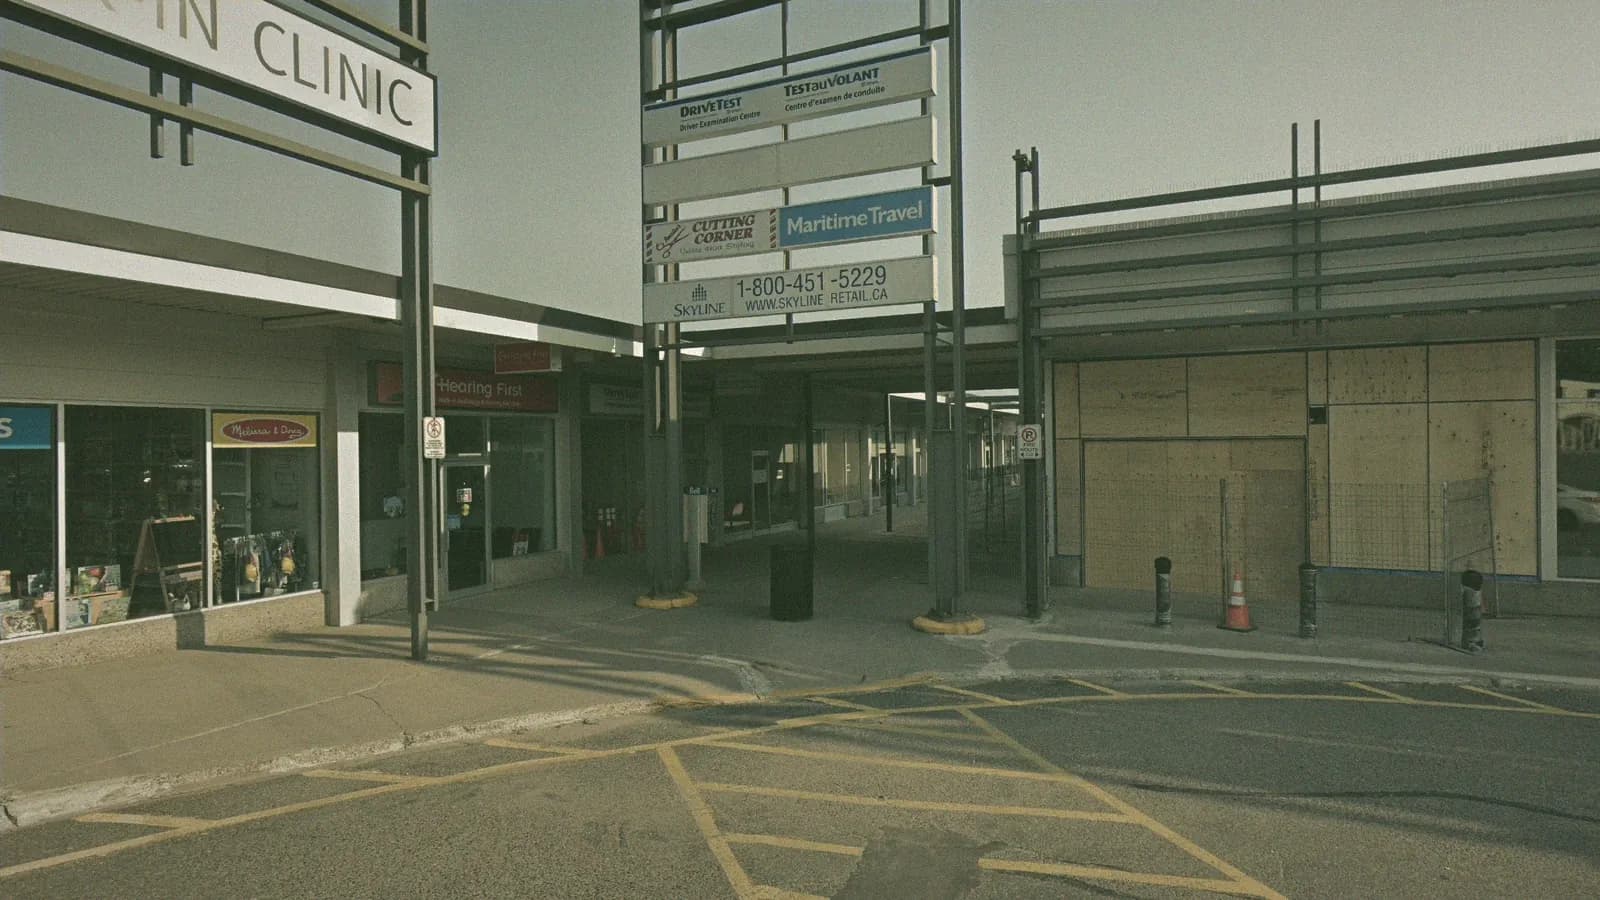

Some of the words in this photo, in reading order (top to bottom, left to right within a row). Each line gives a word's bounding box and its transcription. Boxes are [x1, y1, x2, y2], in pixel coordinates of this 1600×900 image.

[254, 21, 413, 126] CLINIC
[843, 91, 853, 100] de
[679, 122, 699, 132] Driver
[699, 114, 739, 129] Examination
[739, 111, 761, 121] Centre
[692, 215, 755, 232] CUTTING
[867, 201, 923, 225] Travel
[694, 227, 753, 245] CORNER
[437, 378, 493, 399] Hearing
[496, 382, 522, 397] First
